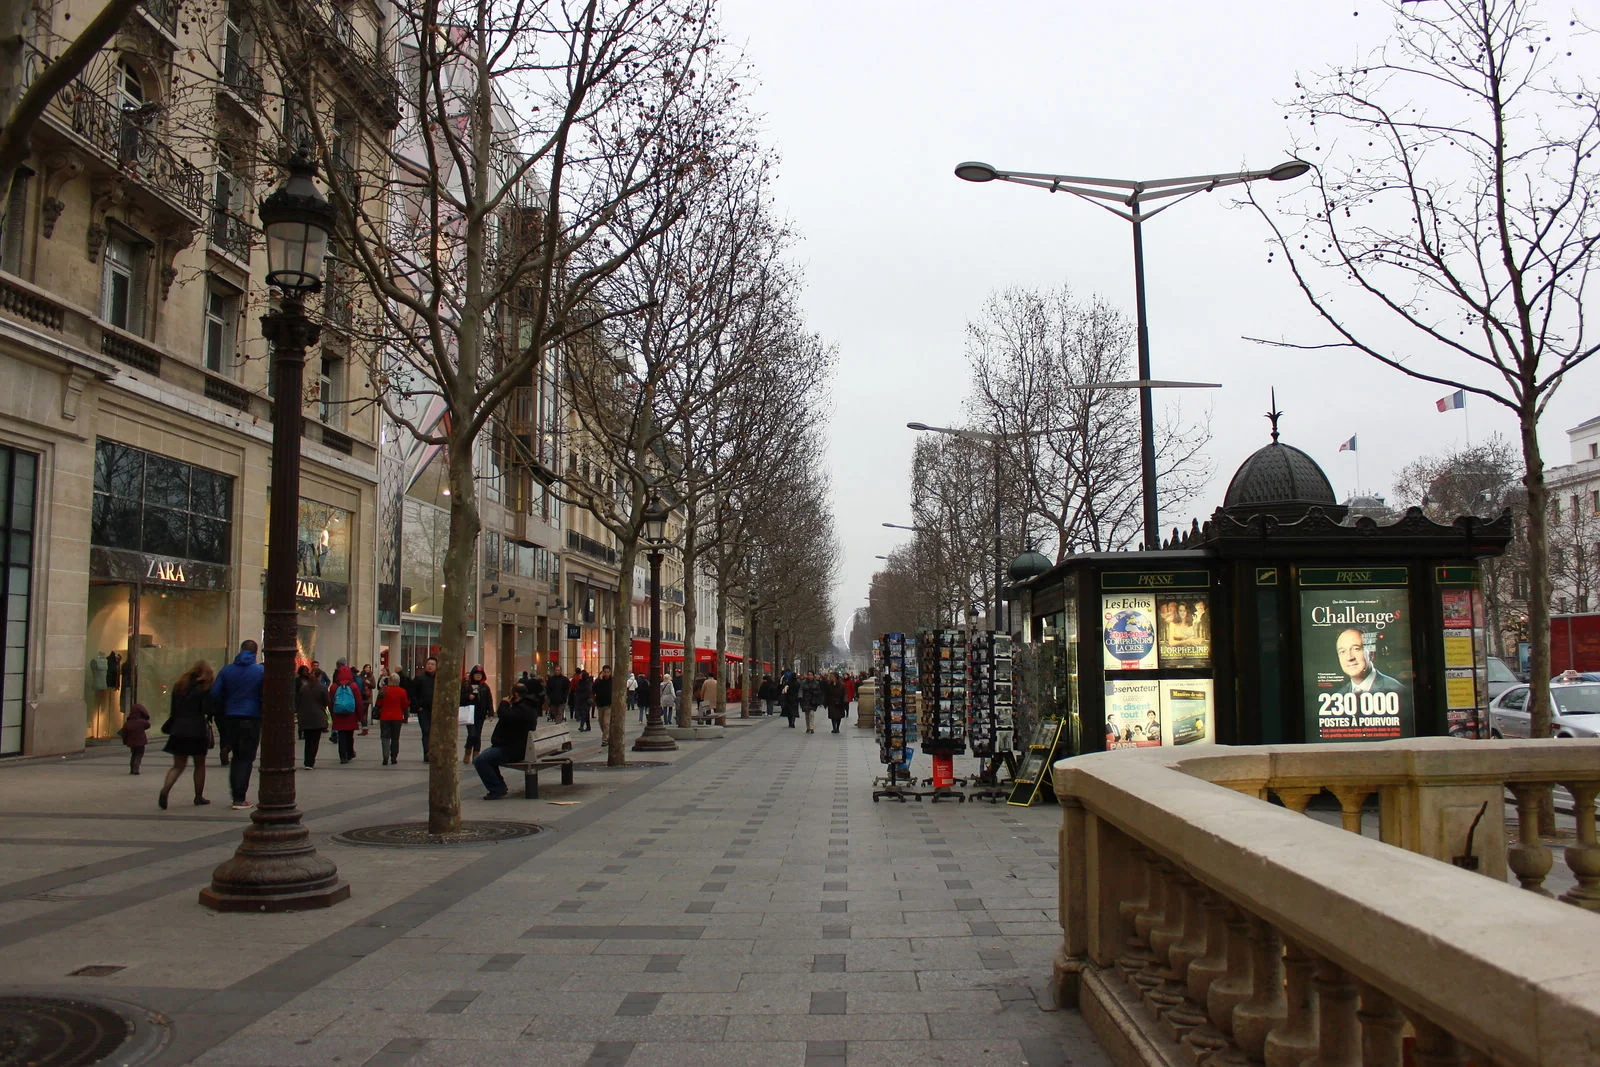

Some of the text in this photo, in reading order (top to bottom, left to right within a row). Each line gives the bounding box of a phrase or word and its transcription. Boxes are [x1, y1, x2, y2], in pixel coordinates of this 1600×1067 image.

[147, 560, 186, 582] ZARA
[1336, 571, 1372, 583] PRESSE
[1138, 574, 1174, 587] PRESSE
[296, 580, 321, 598] ZARA
[1105, 599, 1120, 609] Les
[1122, 597, 1151, 609] Echos
[1311, 606, 1401, 630] Challenges
[1125, 644, 1144, 652] CRISE
[1318, 692, 1399, 716] 230 000
[1319, 715, 1400, 727] POSTES À POURVOIR
